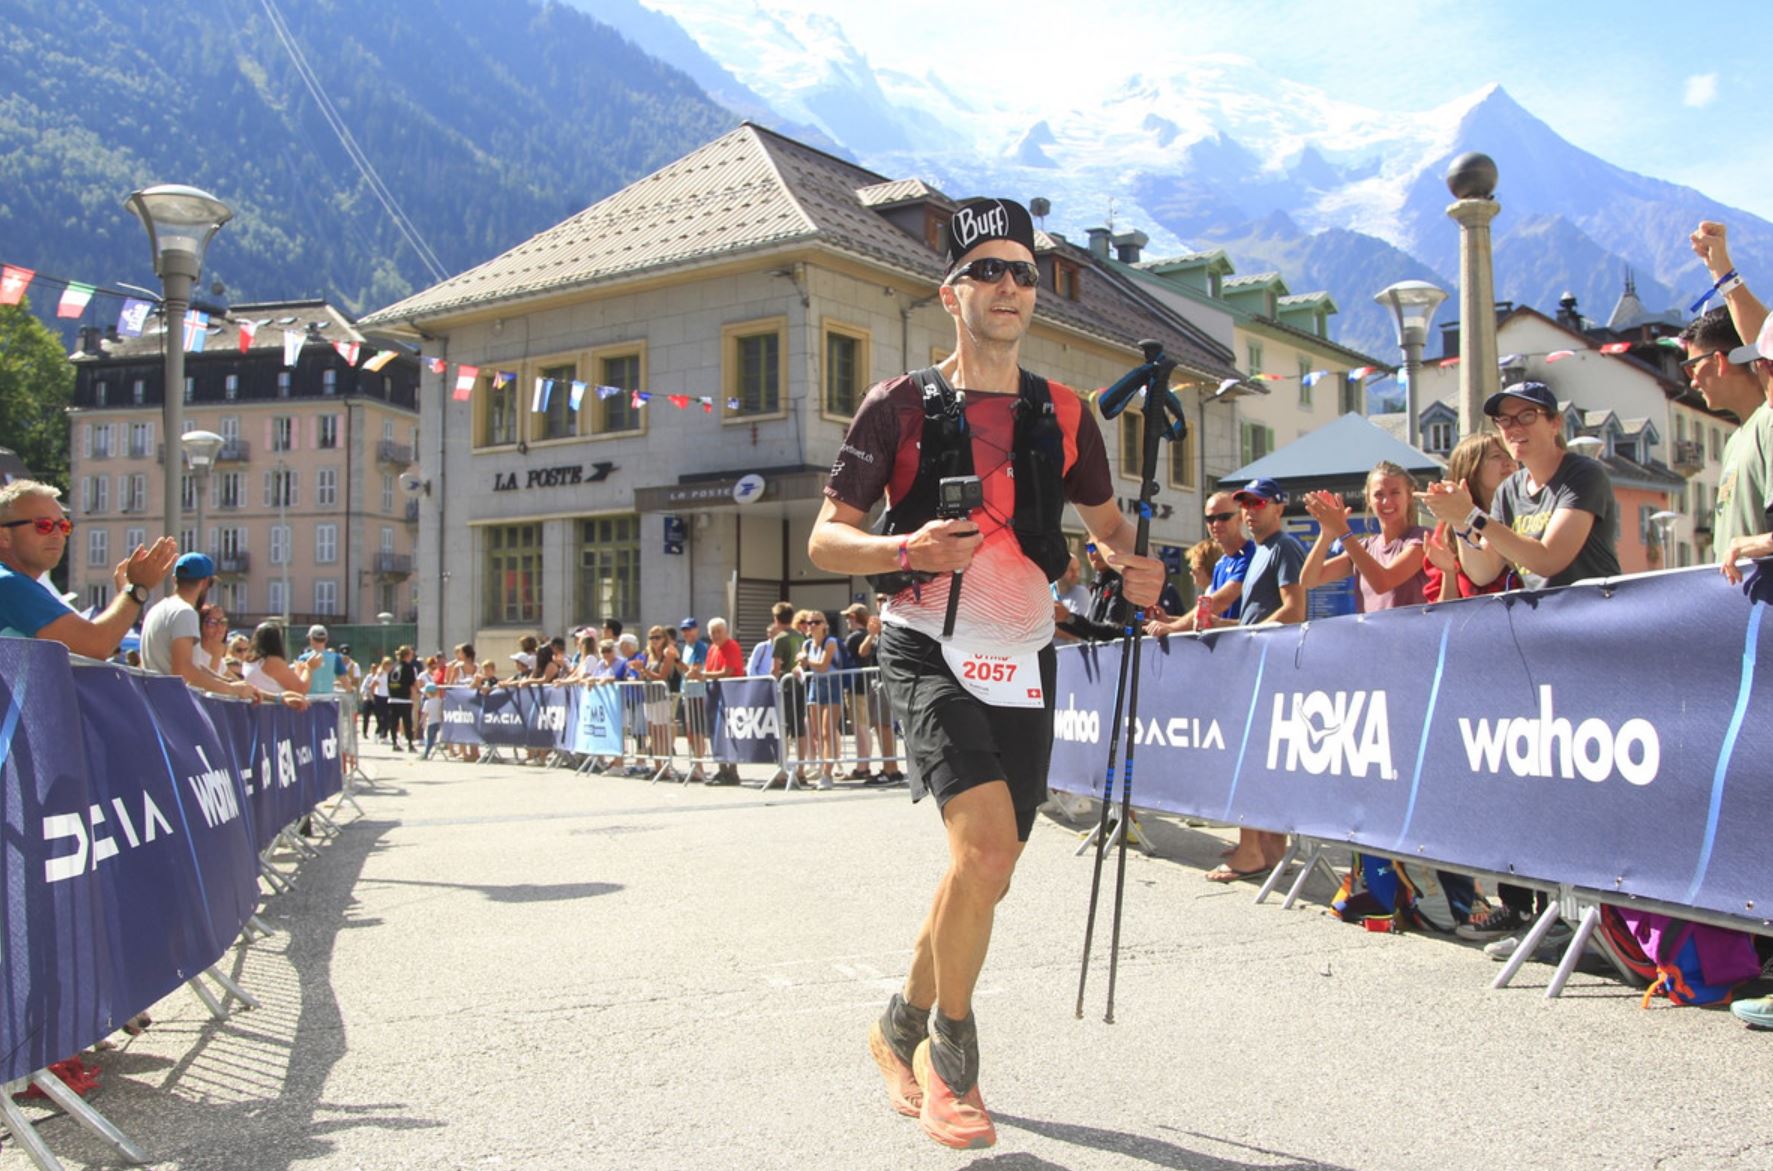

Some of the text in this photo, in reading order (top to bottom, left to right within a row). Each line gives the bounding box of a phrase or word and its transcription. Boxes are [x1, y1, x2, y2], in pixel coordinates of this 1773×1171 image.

[493, 465, 583, 491] LA POSTE
[963, 661, 1018, 682] 2057
[484, 712, 522, 725] DACIA
[725, 706, 780, 739] HOKA
[1054, 692, 1099, 744] wahoo
[1266, 690, 1393, 780] HOKA
[1458, 684, 1660, 786] wahoo
